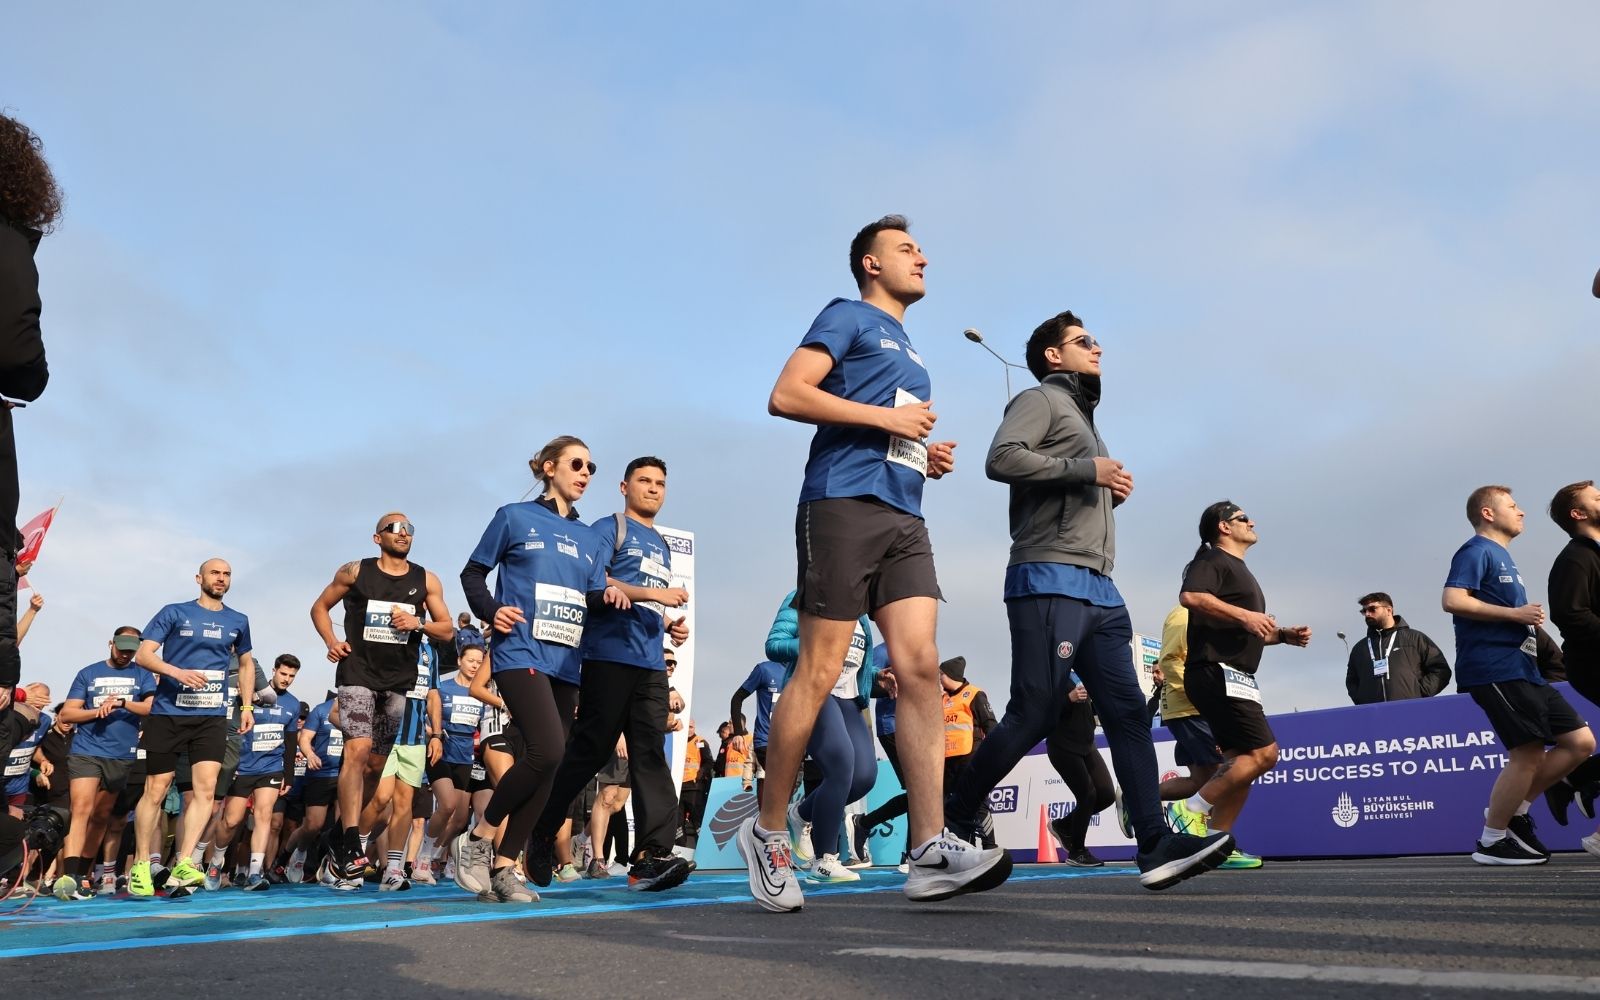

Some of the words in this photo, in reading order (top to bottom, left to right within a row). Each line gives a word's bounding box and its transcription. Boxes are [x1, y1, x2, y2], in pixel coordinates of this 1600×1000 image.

[896, 450, 926, 470] MARATHO
[670, 546, 692, 554] TANBUL
[642, 576, 648, 586] J
[370, 614, 378, 624] P
[380, 615, 392, 625] 19
[542, 603, 550, 616] J
[553, 604, 583, 623] 11508
[540, 630, 575, 643] MARATHON
[462, 705, 480, 714] 20312
[1375, 731, 1495, 754] BAŞARILAR
[1251, 770, 1287, 785] ISH
[1293, 763, 1384, 782] SUCCESS
[1389, 761, 1417, 775] TO
[1424, 758, 1464, 773] ALL
[1470, 754, 1509, 770] ATH
[988, 788, 1014, 802] OR
[989, 802, 1014, 811] NBUL
[1364, 800, 1434, 813] BÜYÜKŞEHİR
[1364, 812, 1413, 820] BELEDİYESİ
